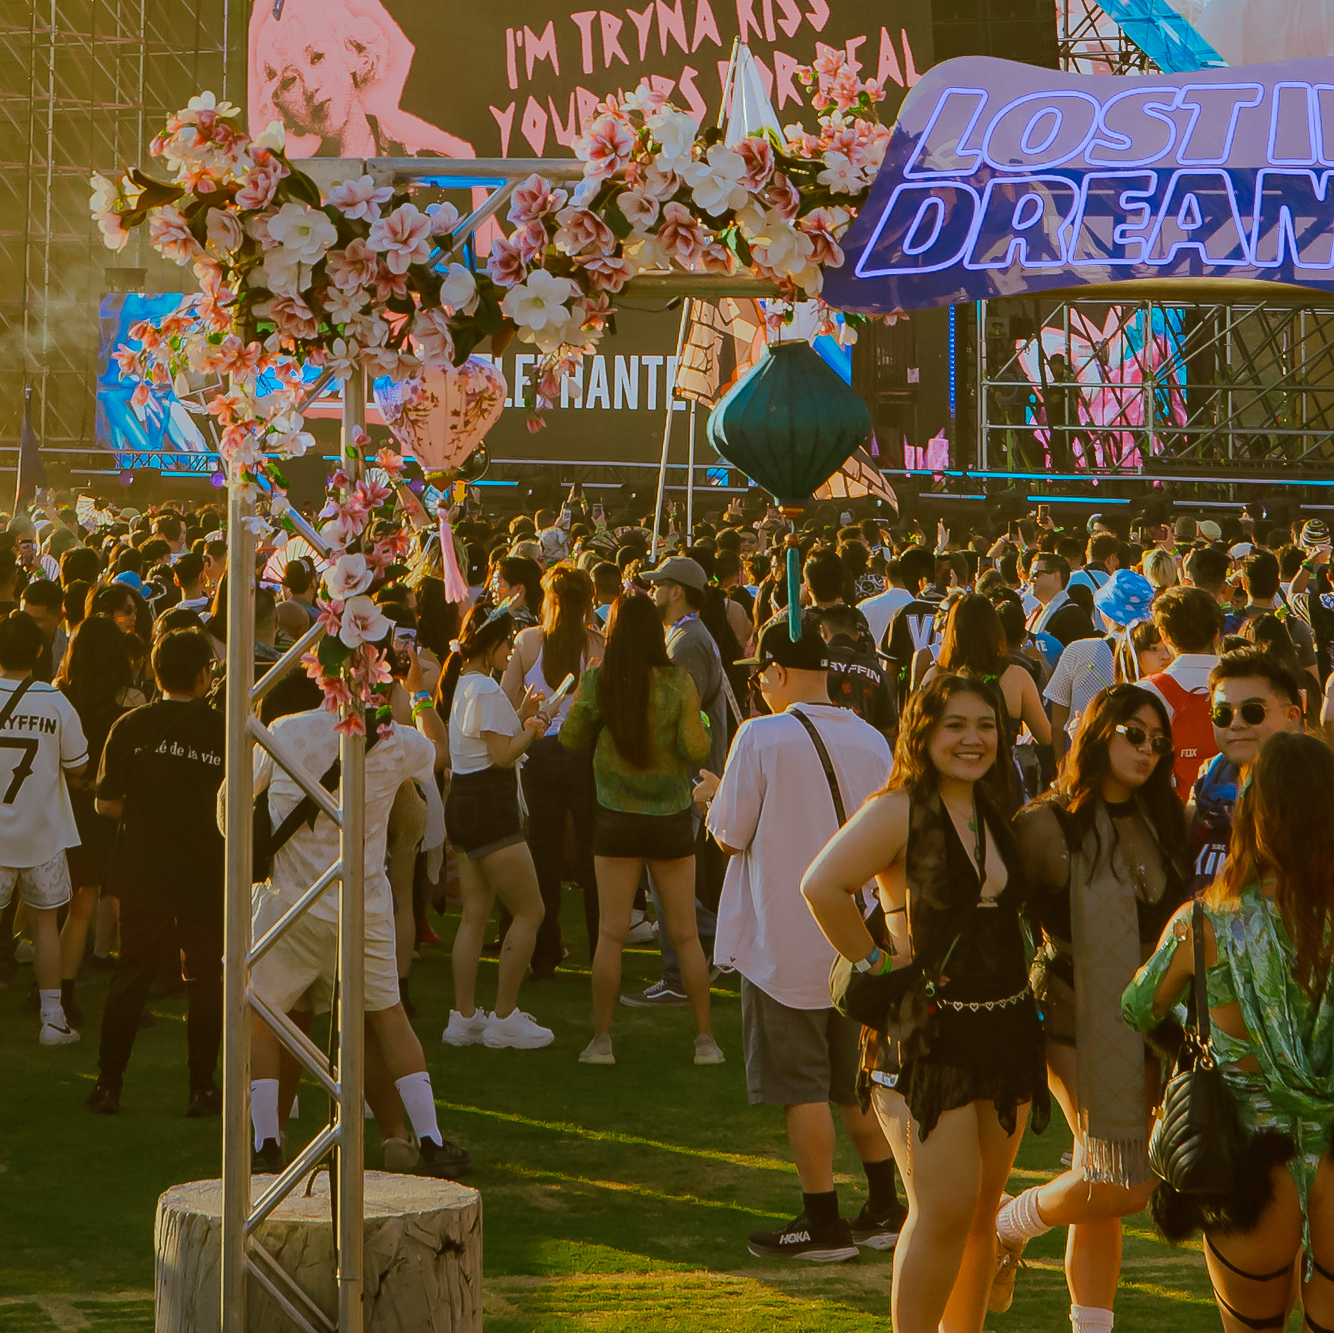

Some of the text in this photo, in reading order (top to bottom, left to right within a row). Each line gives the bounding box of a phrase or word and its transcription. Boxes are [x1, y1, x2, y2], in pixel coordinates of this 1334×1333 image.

[505, 20, 560, 90] I'M
[903, 82, 1266, 179] LOST
[475, 353, 687, 411] LEHANTE
[829, 660, 881, 685] RYFFIN
[170, 741, 184, 757] de
[187, 745, 198, 760] la
[201, 751, 221, 766] vie
[1180, 748, 1198, 758] FOX
[779, 1230, 811, 1245] HOKA
